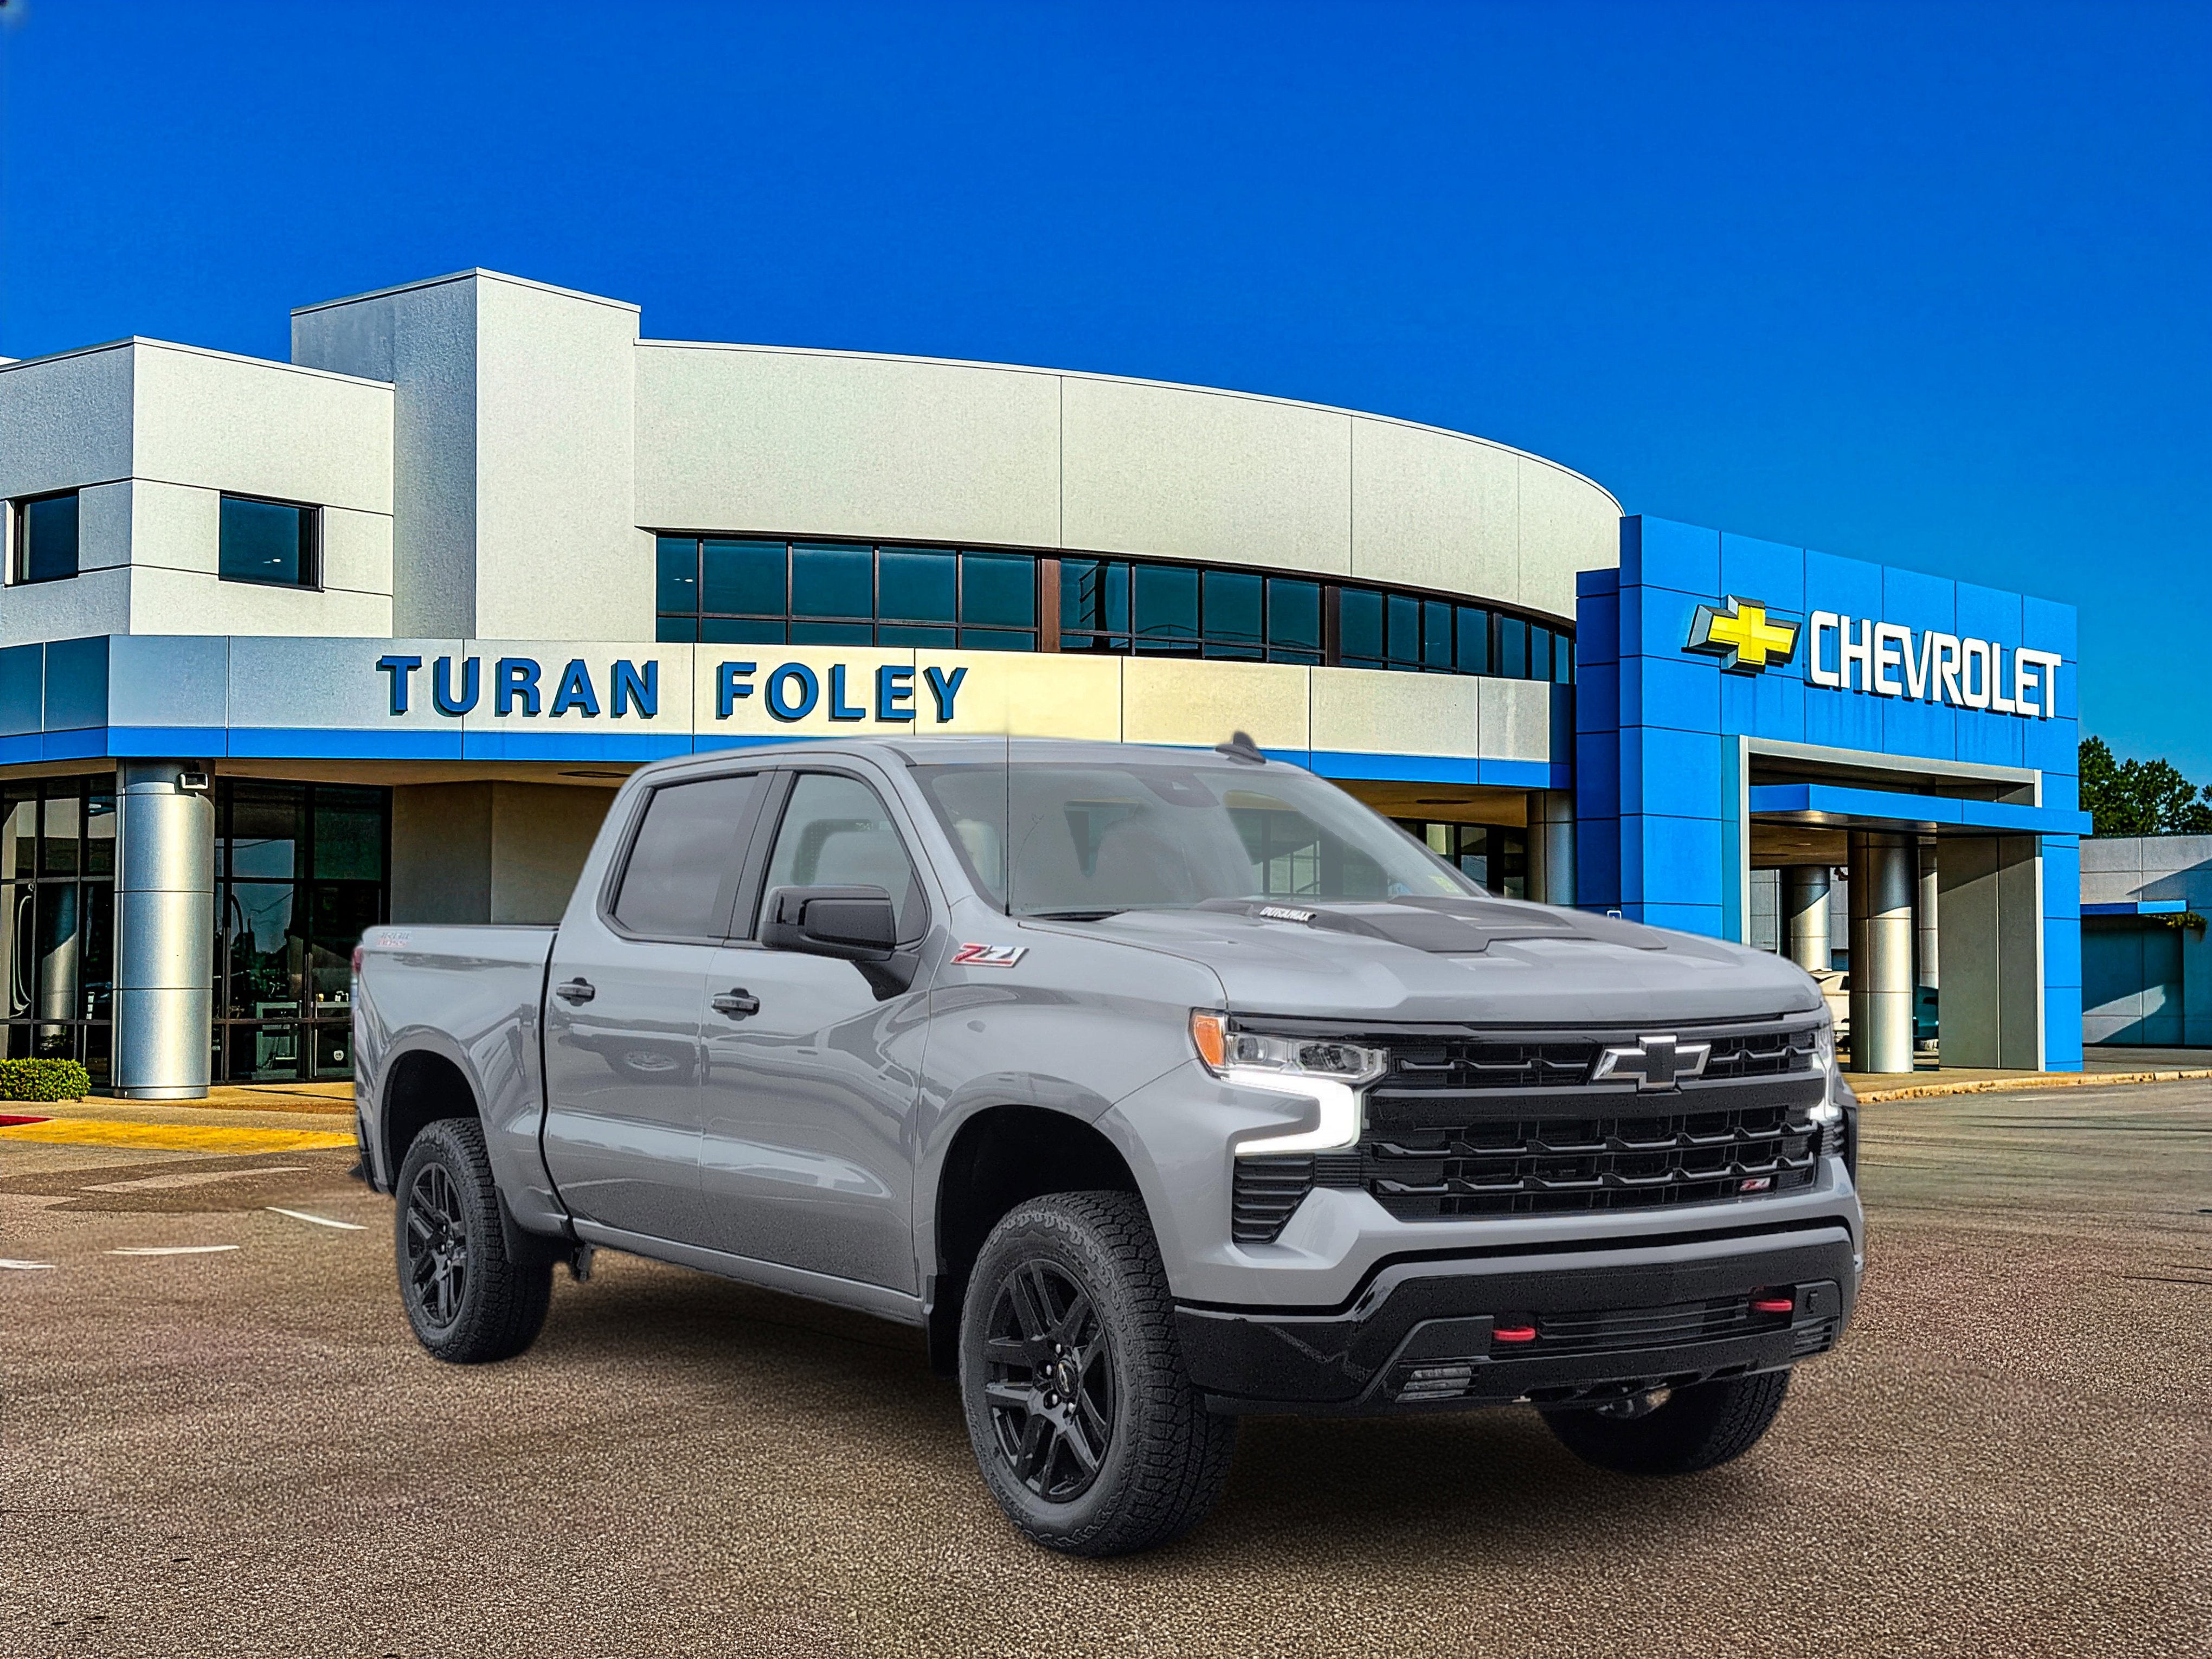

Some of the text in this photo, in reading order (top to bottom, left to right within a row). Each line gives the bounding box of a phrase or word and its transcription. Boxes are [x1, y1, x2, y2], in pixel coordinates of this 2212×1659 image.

[376, 654, 968, 724] TURAN FOLEY
[1809, 610, 2062, 718] CHEVROLET
[950, 943, 1030, 968] Z71
